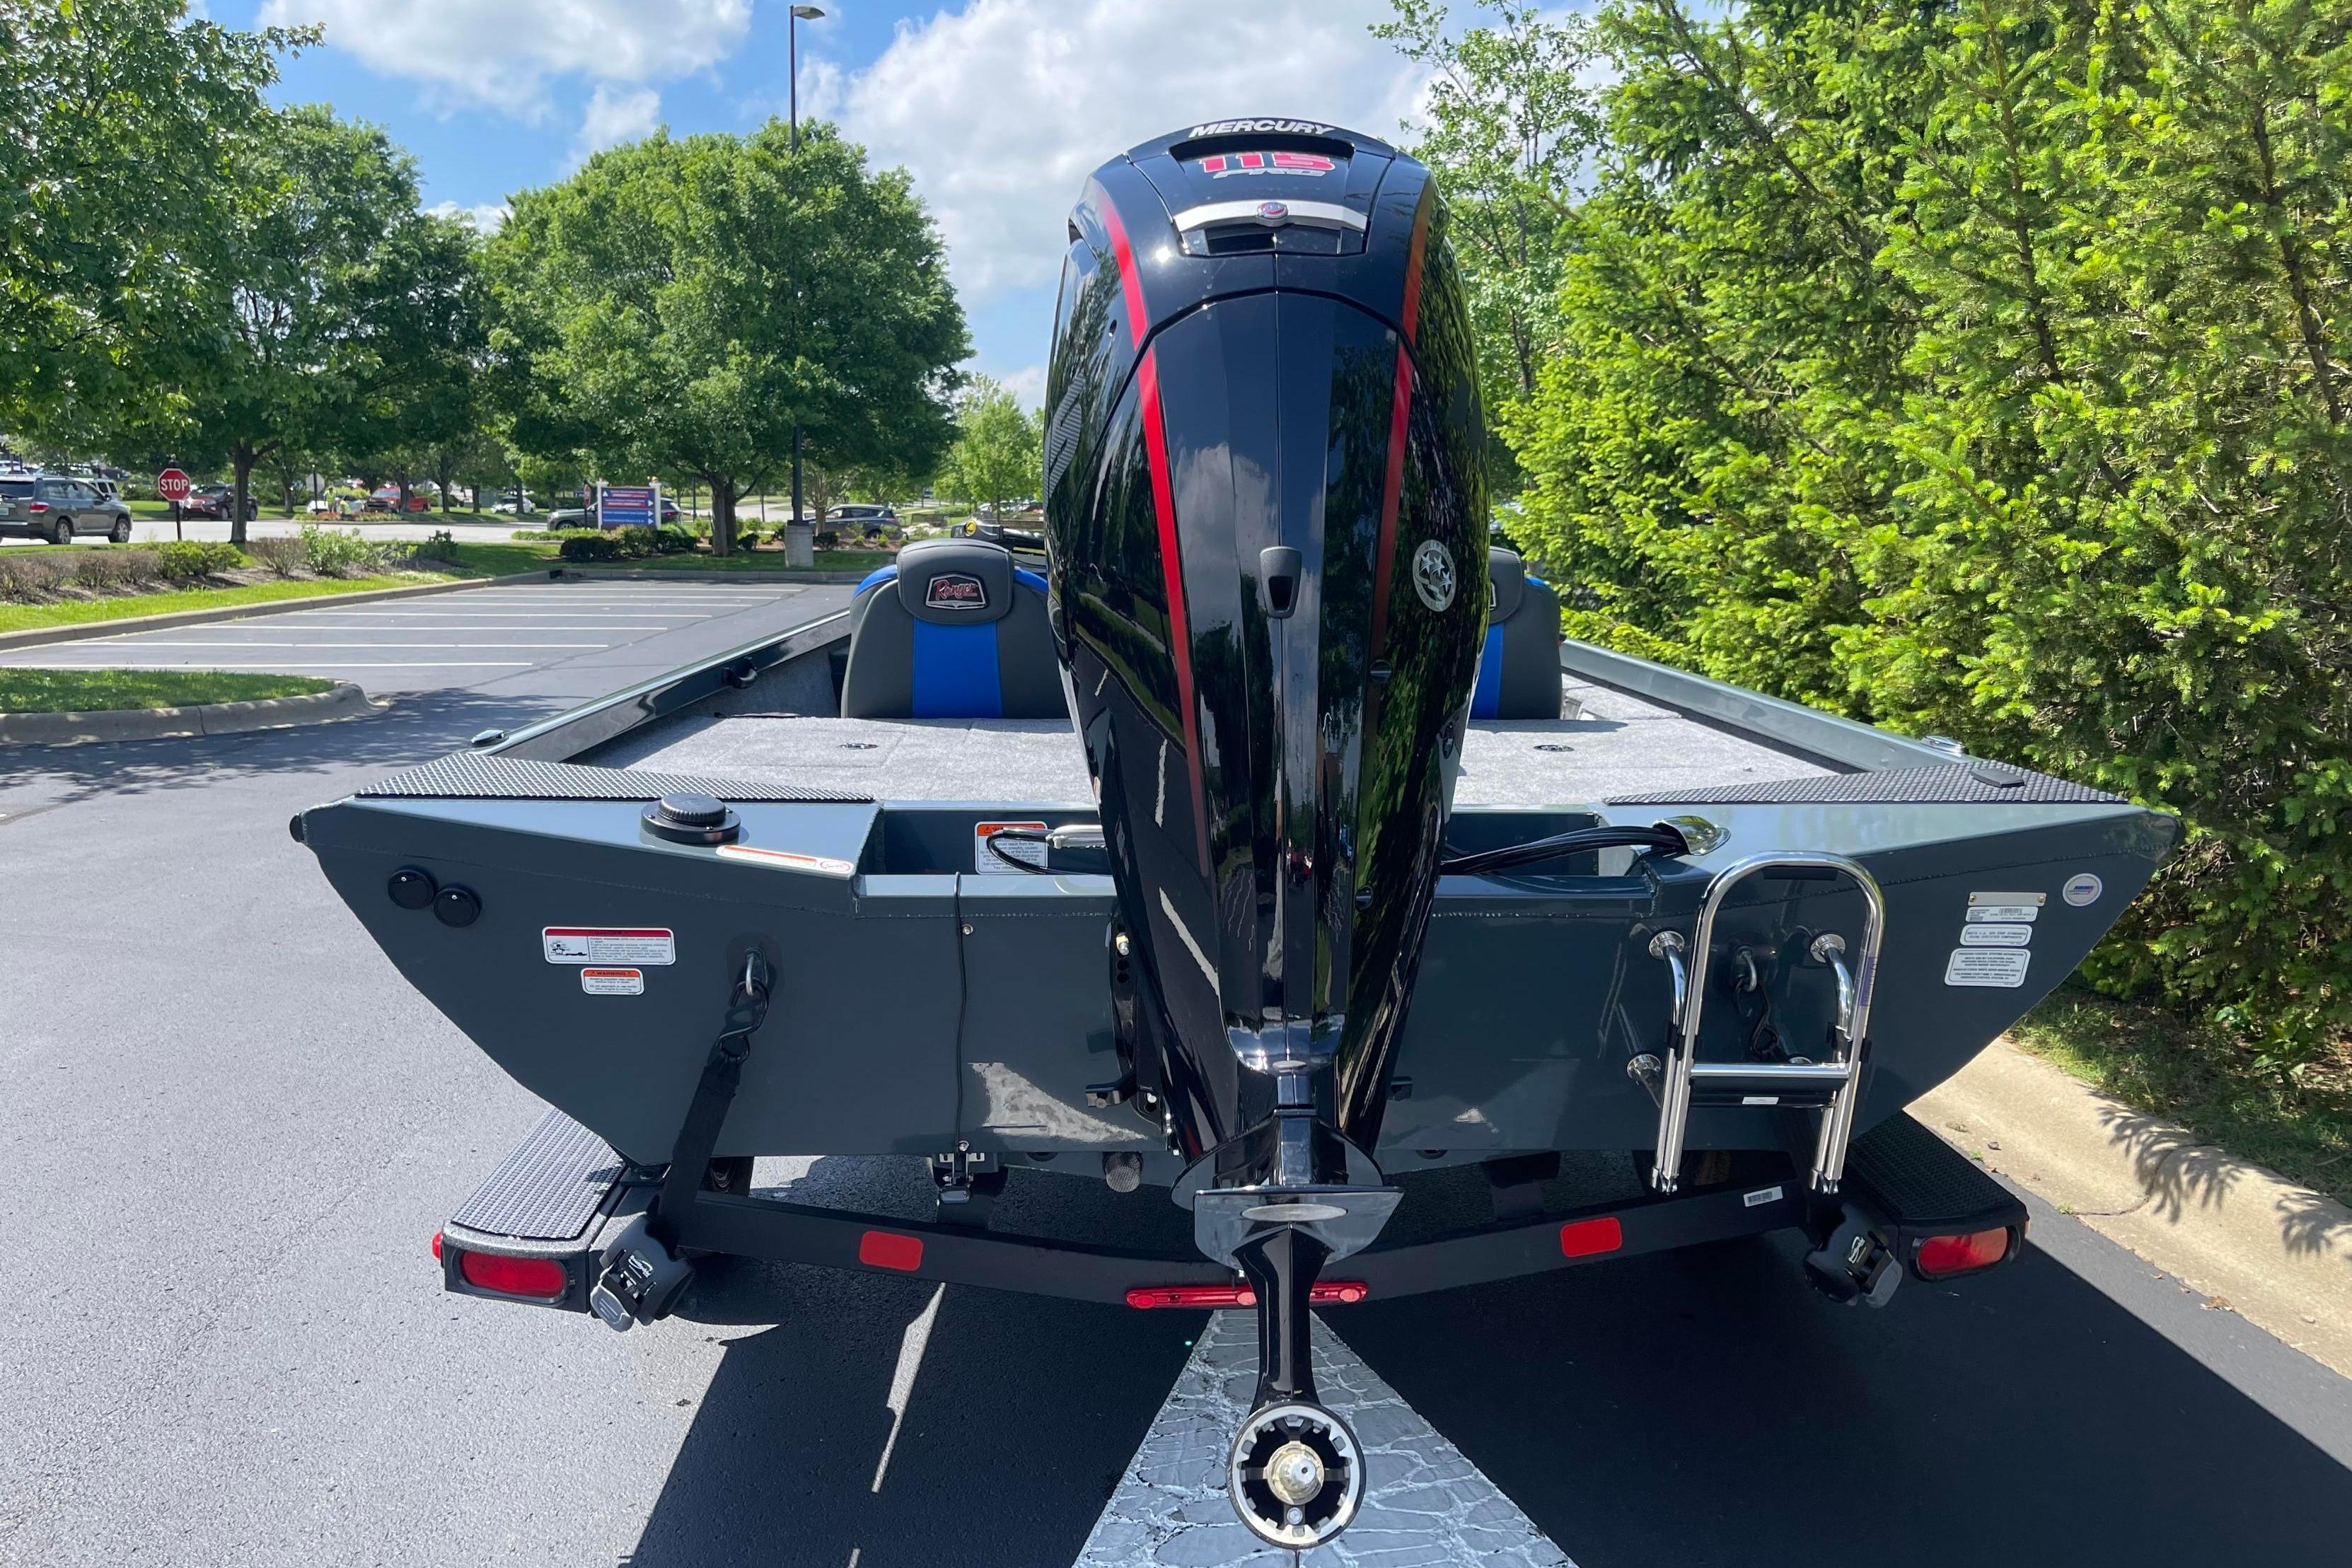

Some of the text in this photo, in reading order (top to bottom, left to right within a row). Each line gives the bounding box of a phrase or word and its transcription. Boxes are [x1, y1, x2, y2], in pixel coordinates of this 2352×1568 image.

[1188, 120, 1336, 139] MERCURY
[1199, 151, 1336, 173] 115
[161, 479, 188, 491] STOP
[933, 579, 979, 601] Ranger
